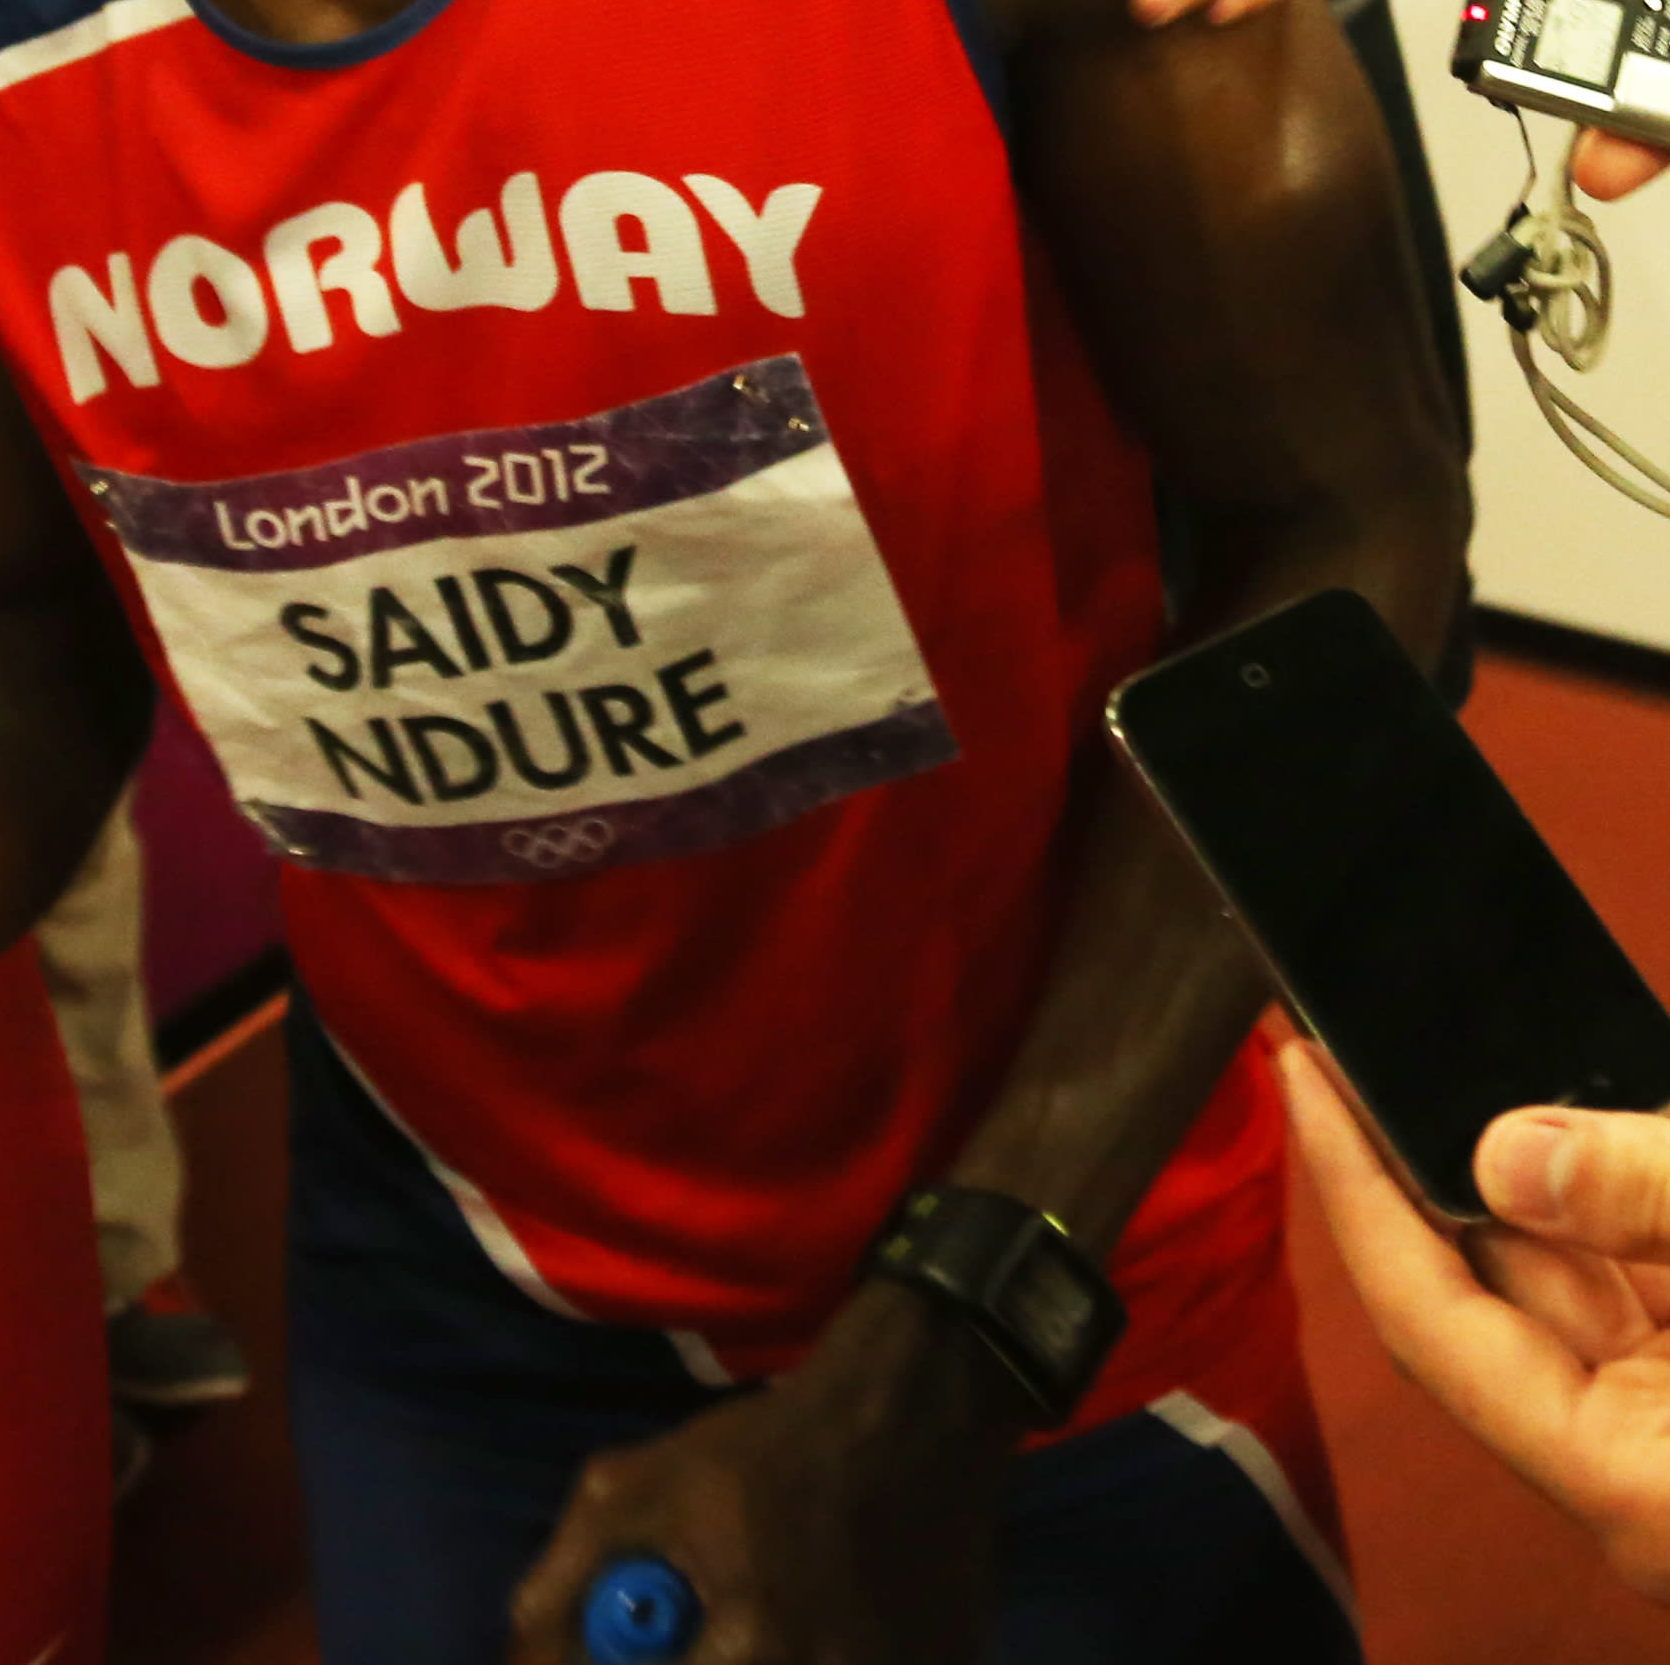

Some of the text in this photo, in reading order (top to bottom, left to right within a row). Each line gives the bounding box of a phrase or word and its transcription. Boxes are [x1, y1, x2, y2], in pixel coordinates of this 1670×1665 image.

[48, 170, 822, 405] NORWAY
[214, 443, 612, 552] London 2012
[278, 545, 644, 692] SAIDY
[303, 648, 747, 806] NDURE
